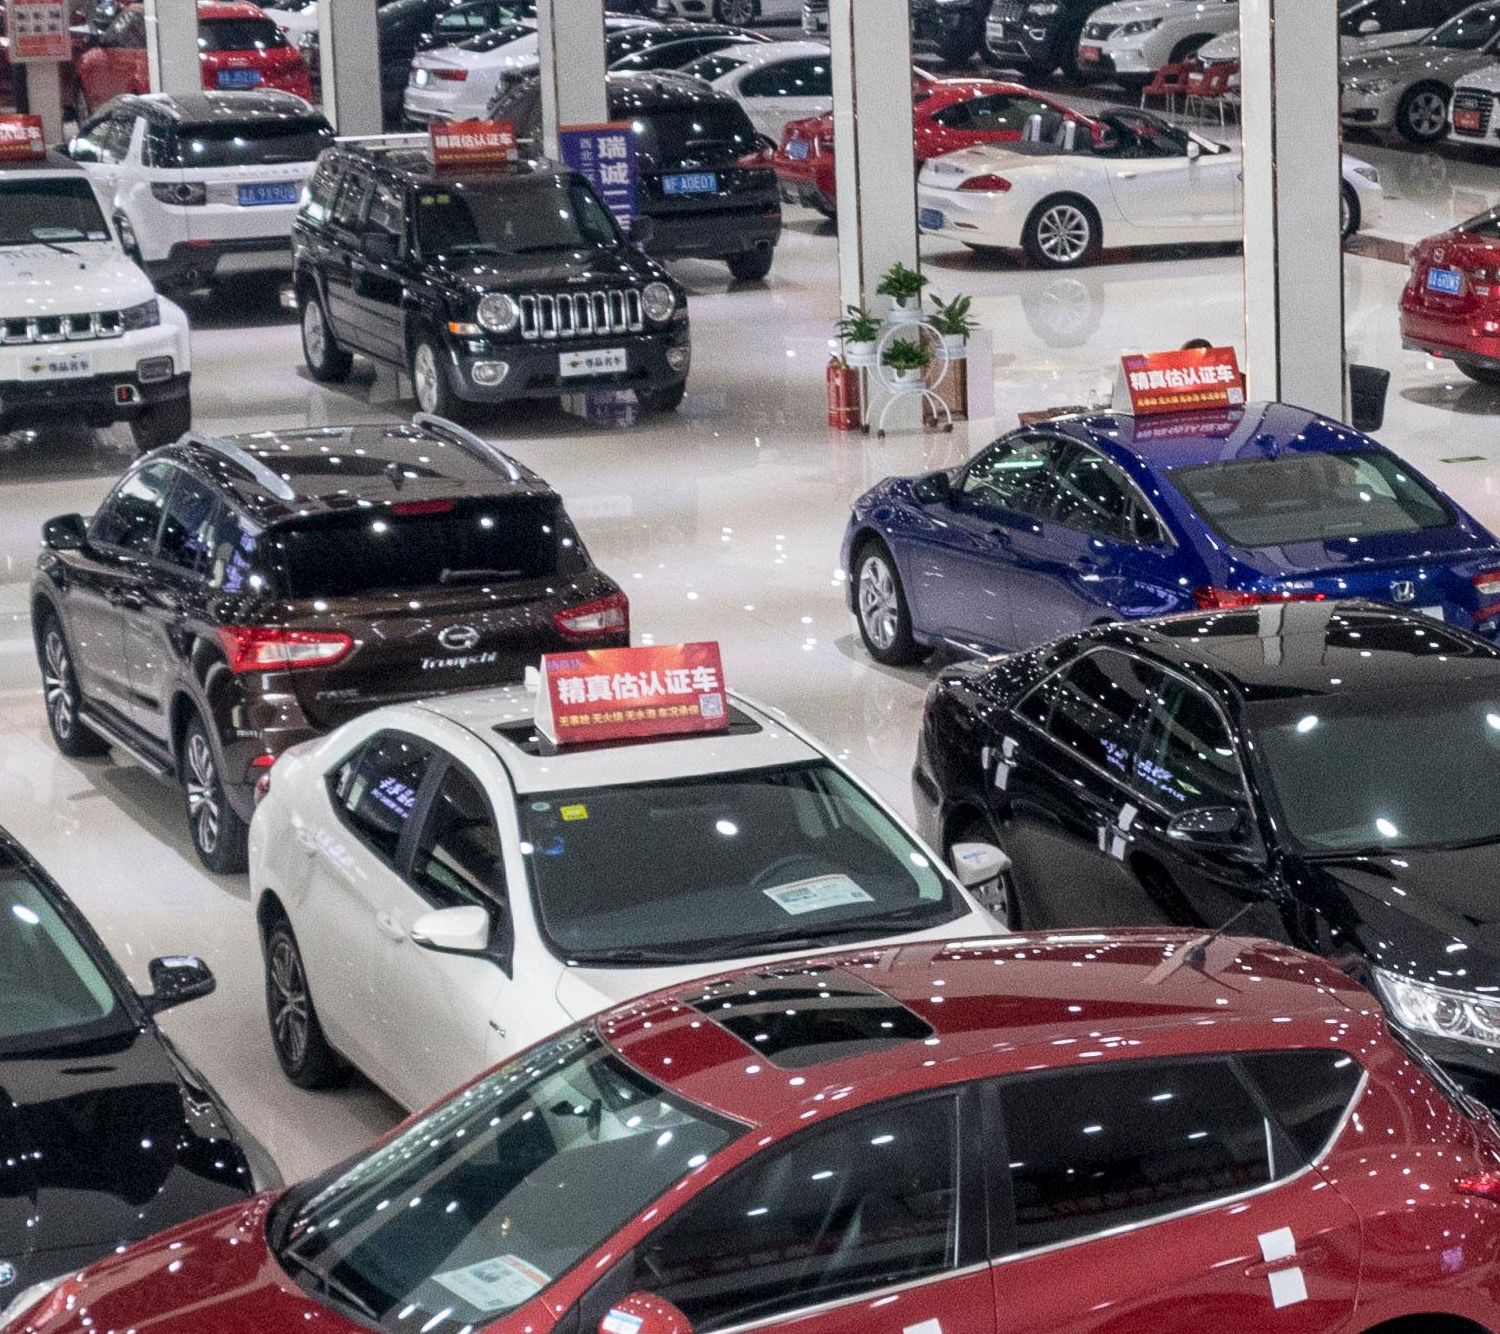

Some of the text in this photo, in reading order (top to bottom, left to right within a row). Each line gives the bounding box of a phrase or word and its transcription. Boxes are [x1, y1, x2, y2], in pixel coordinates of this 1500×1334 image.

[1129, 364, 1235, 391] 精真估认证车
[557, 666, 719, 705] 精真估认证车
